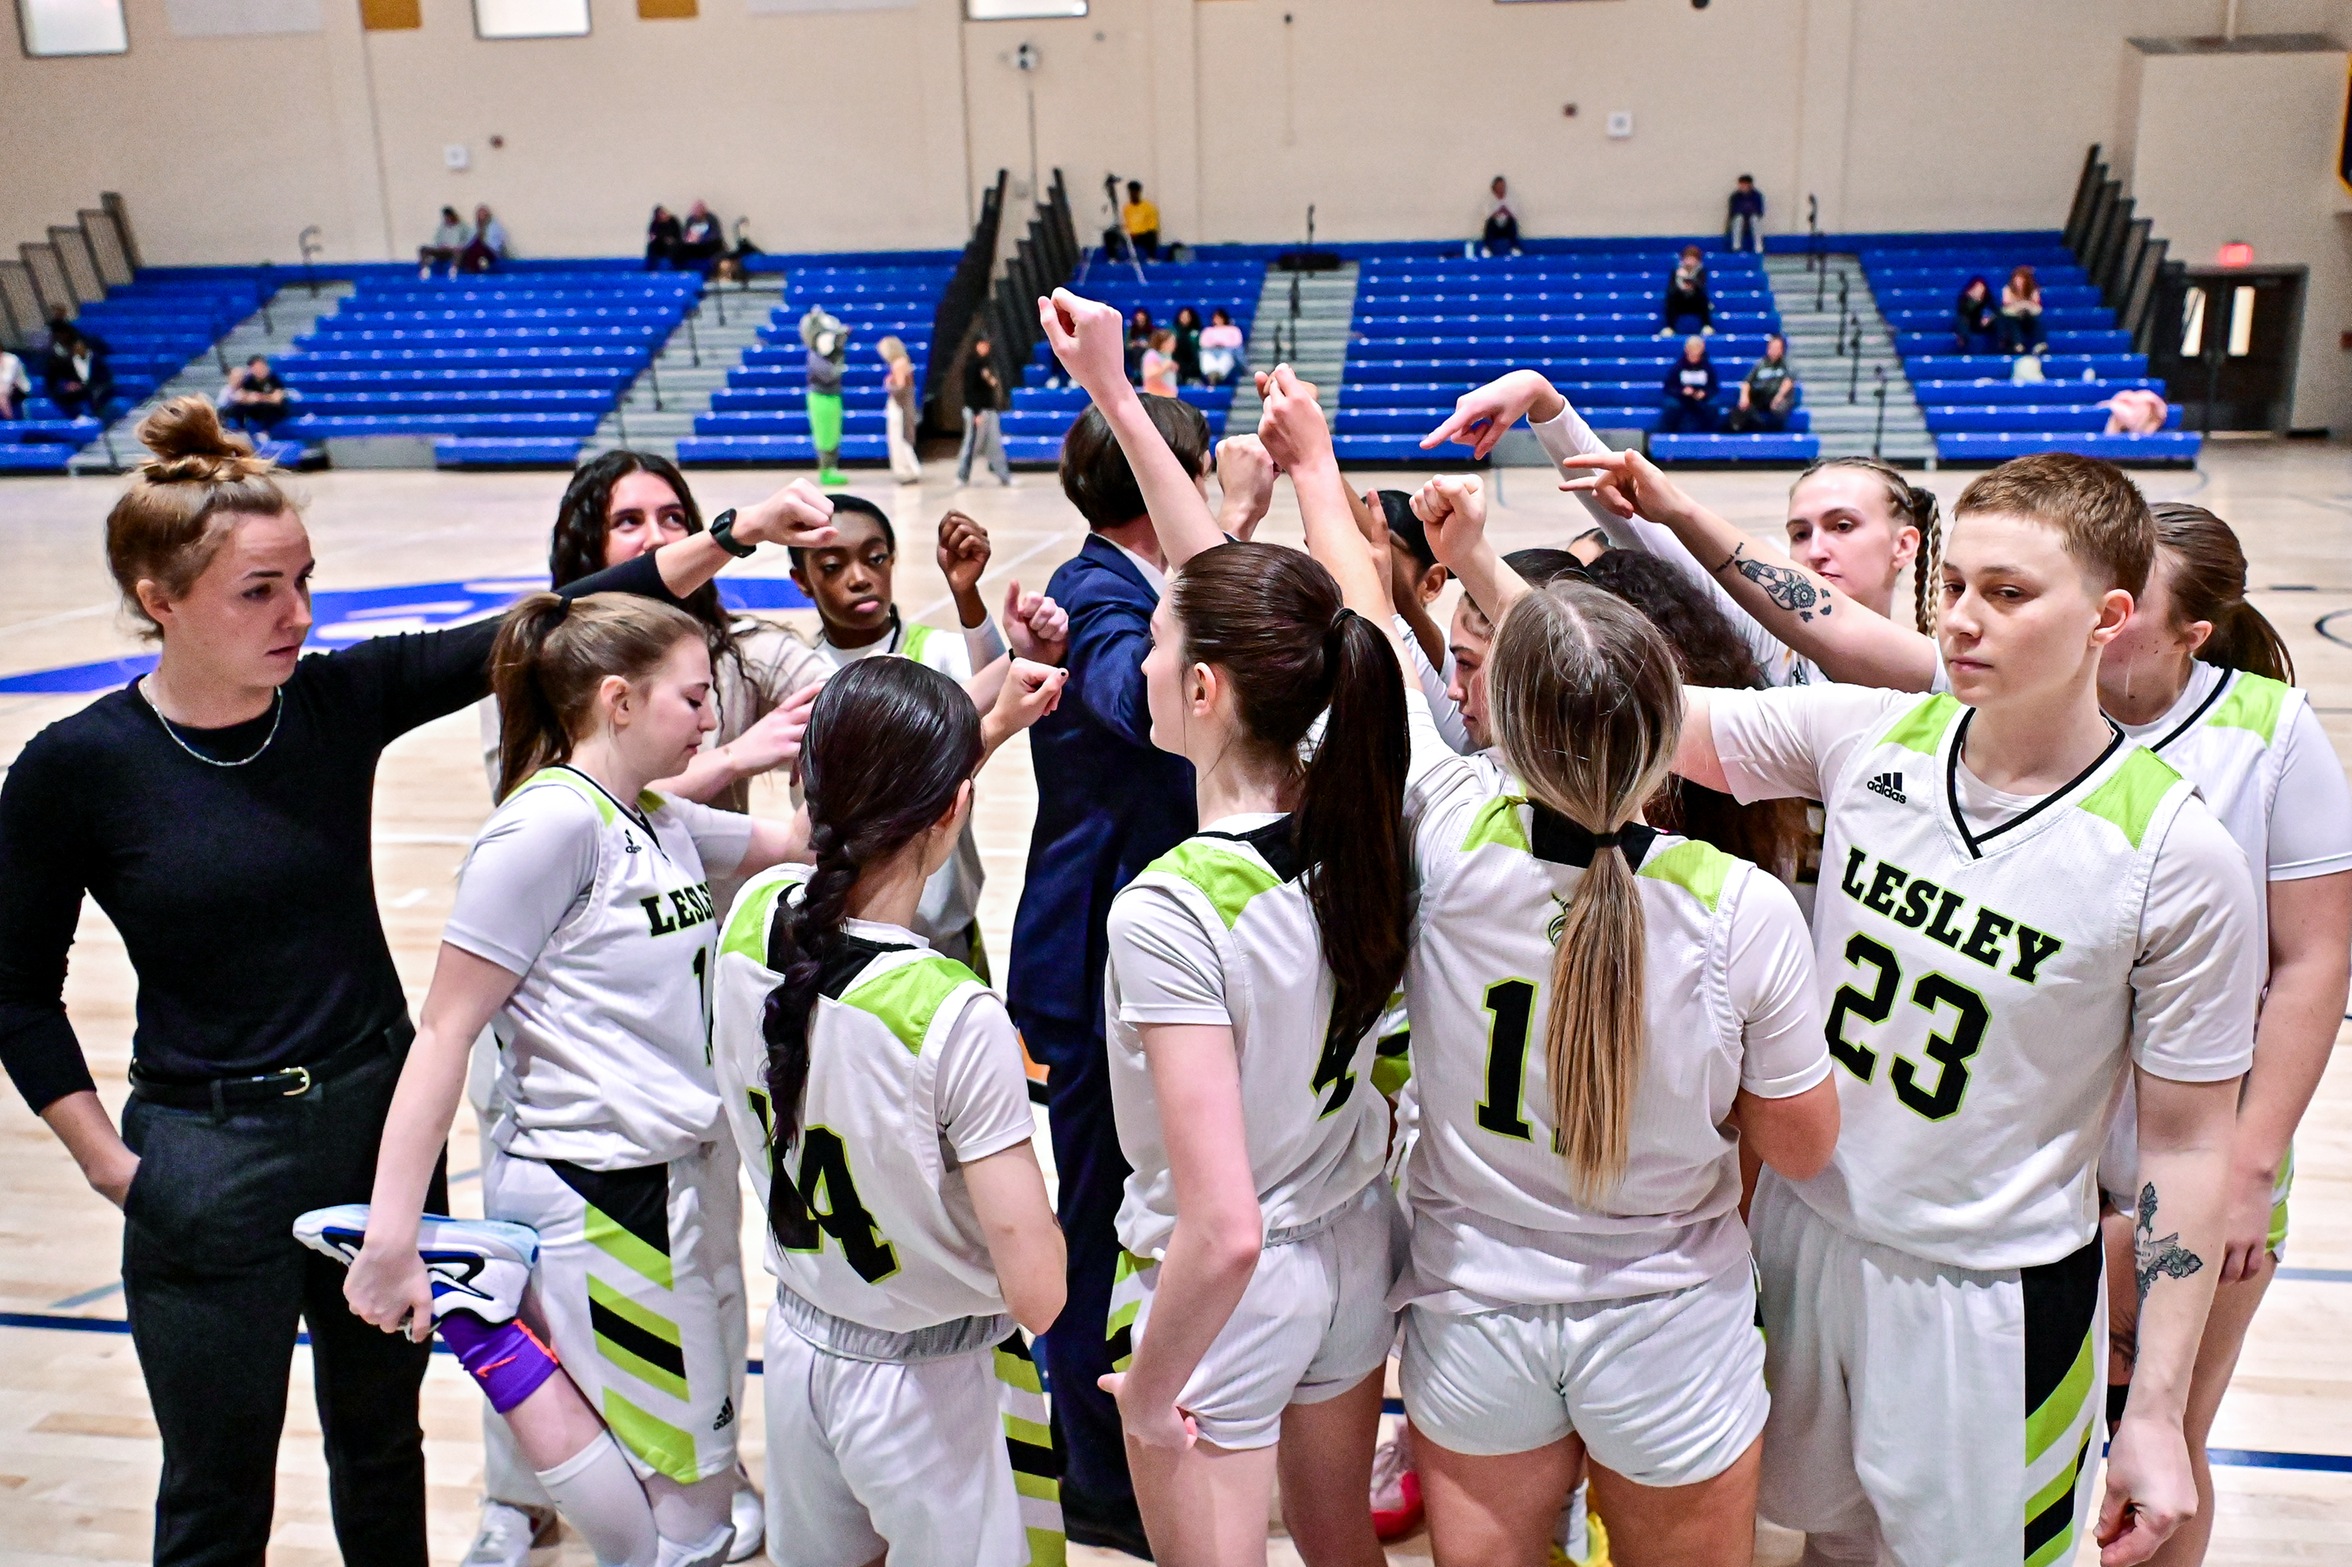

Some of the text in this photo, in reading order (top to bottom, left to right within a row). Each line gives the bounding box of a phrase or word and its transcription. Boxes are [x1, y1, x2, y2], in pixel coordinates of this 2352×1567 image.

[1867, 780, 1907, 805] adidas
[639, 880, 716, 938] LESL
[1841, 844, 2065, 985] LESLEY
[1474, 976, 1572, 1156] 1
[1824, 930, 1993, 1122] 23
